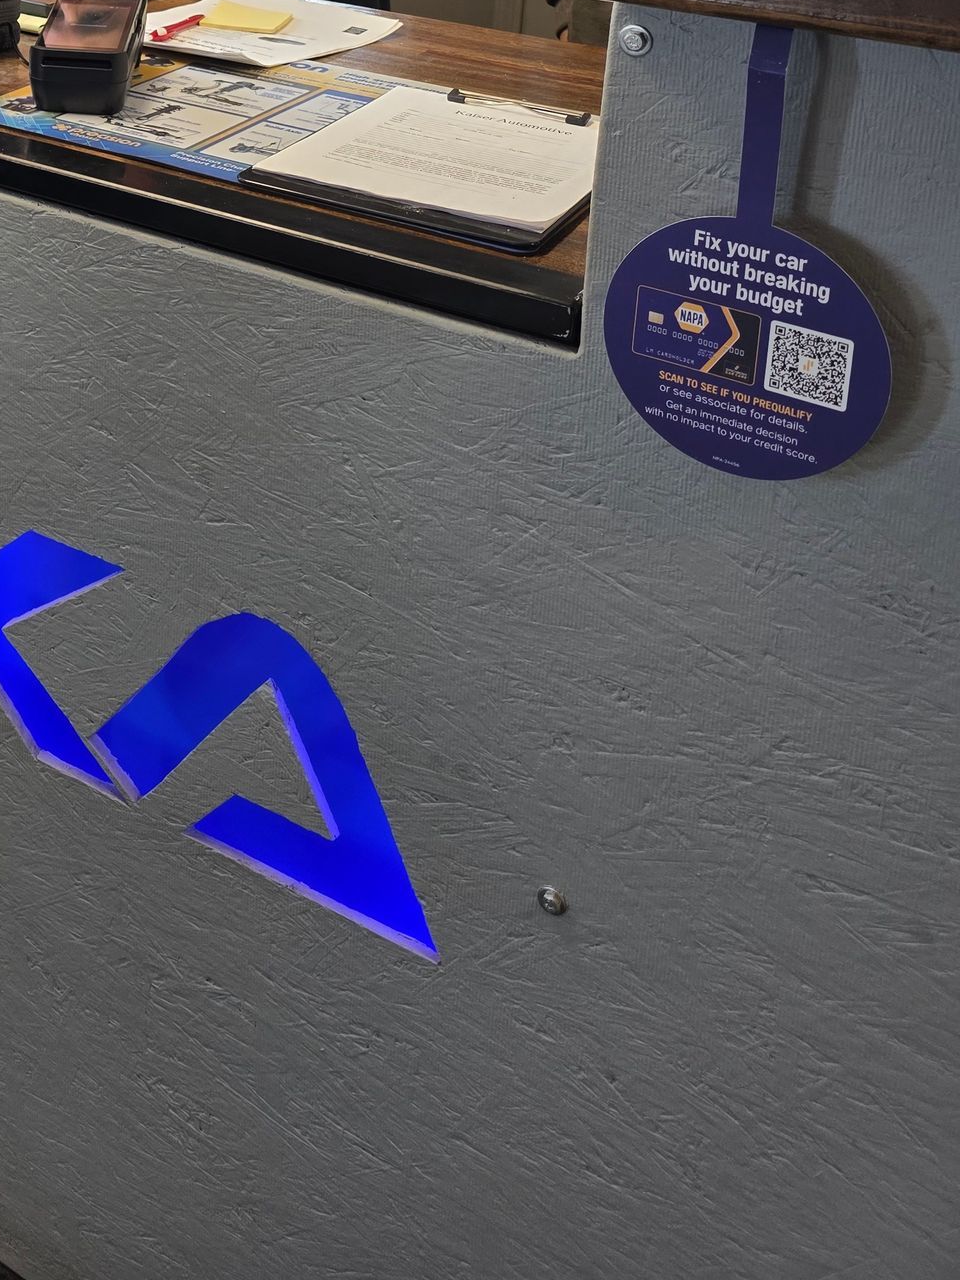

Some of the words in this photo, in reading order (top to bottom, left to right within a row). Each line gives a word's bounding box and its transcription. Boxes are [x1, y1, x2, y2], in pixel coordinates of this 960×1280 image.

[454, 110, 496, 121] Kaiser
[499, 118, 573, 136] Automotive
[693, 229, 721, 252] Fix
[727, 239, 770, 263] your
[775, 252, 808, 272] car
[668, 247, 739, 277] without
[744, 263, 831, 305] breaking
[689, 274, 731, 296] your
[736, 283, 804, 316] budget
[647, 324, 667, 335] 0000
[672, 331, 693, 342] 0000
[698, 338, 718, 349] 0000
[680, 309, 703, 326] NAPA
[658, 370, 684, 387] SCAN
[686, 376, 698, 390] TO
[700, 381, 718, 396] SEE
[721, 386, 730, 398] IF
[732, 389, 751, 404] YOU
[752, 394, 813, 422] PREQUALIFY
[659, 384, 670, 393] or
[673, 388, 693, 400] see
[695, 392, 748, 415] associate
[750, 407, 766, 419] for
[767, 413, 808, 434] details.
[645, 405, 664, 418] with
[666, 412, 679, 423] no
[681, 414, 715, 434] impact
[717, 426, 727, 436] to
[729, 430, 751, 445] your
[754, 435, 784, 455] credit
[785, 446, 818, 465] score.
[665, 399, 681, 412] Get
[683, 405, 697, 415] an
[699, 407, 753, 433] immediate
[755, 424, 798, 446] decision
